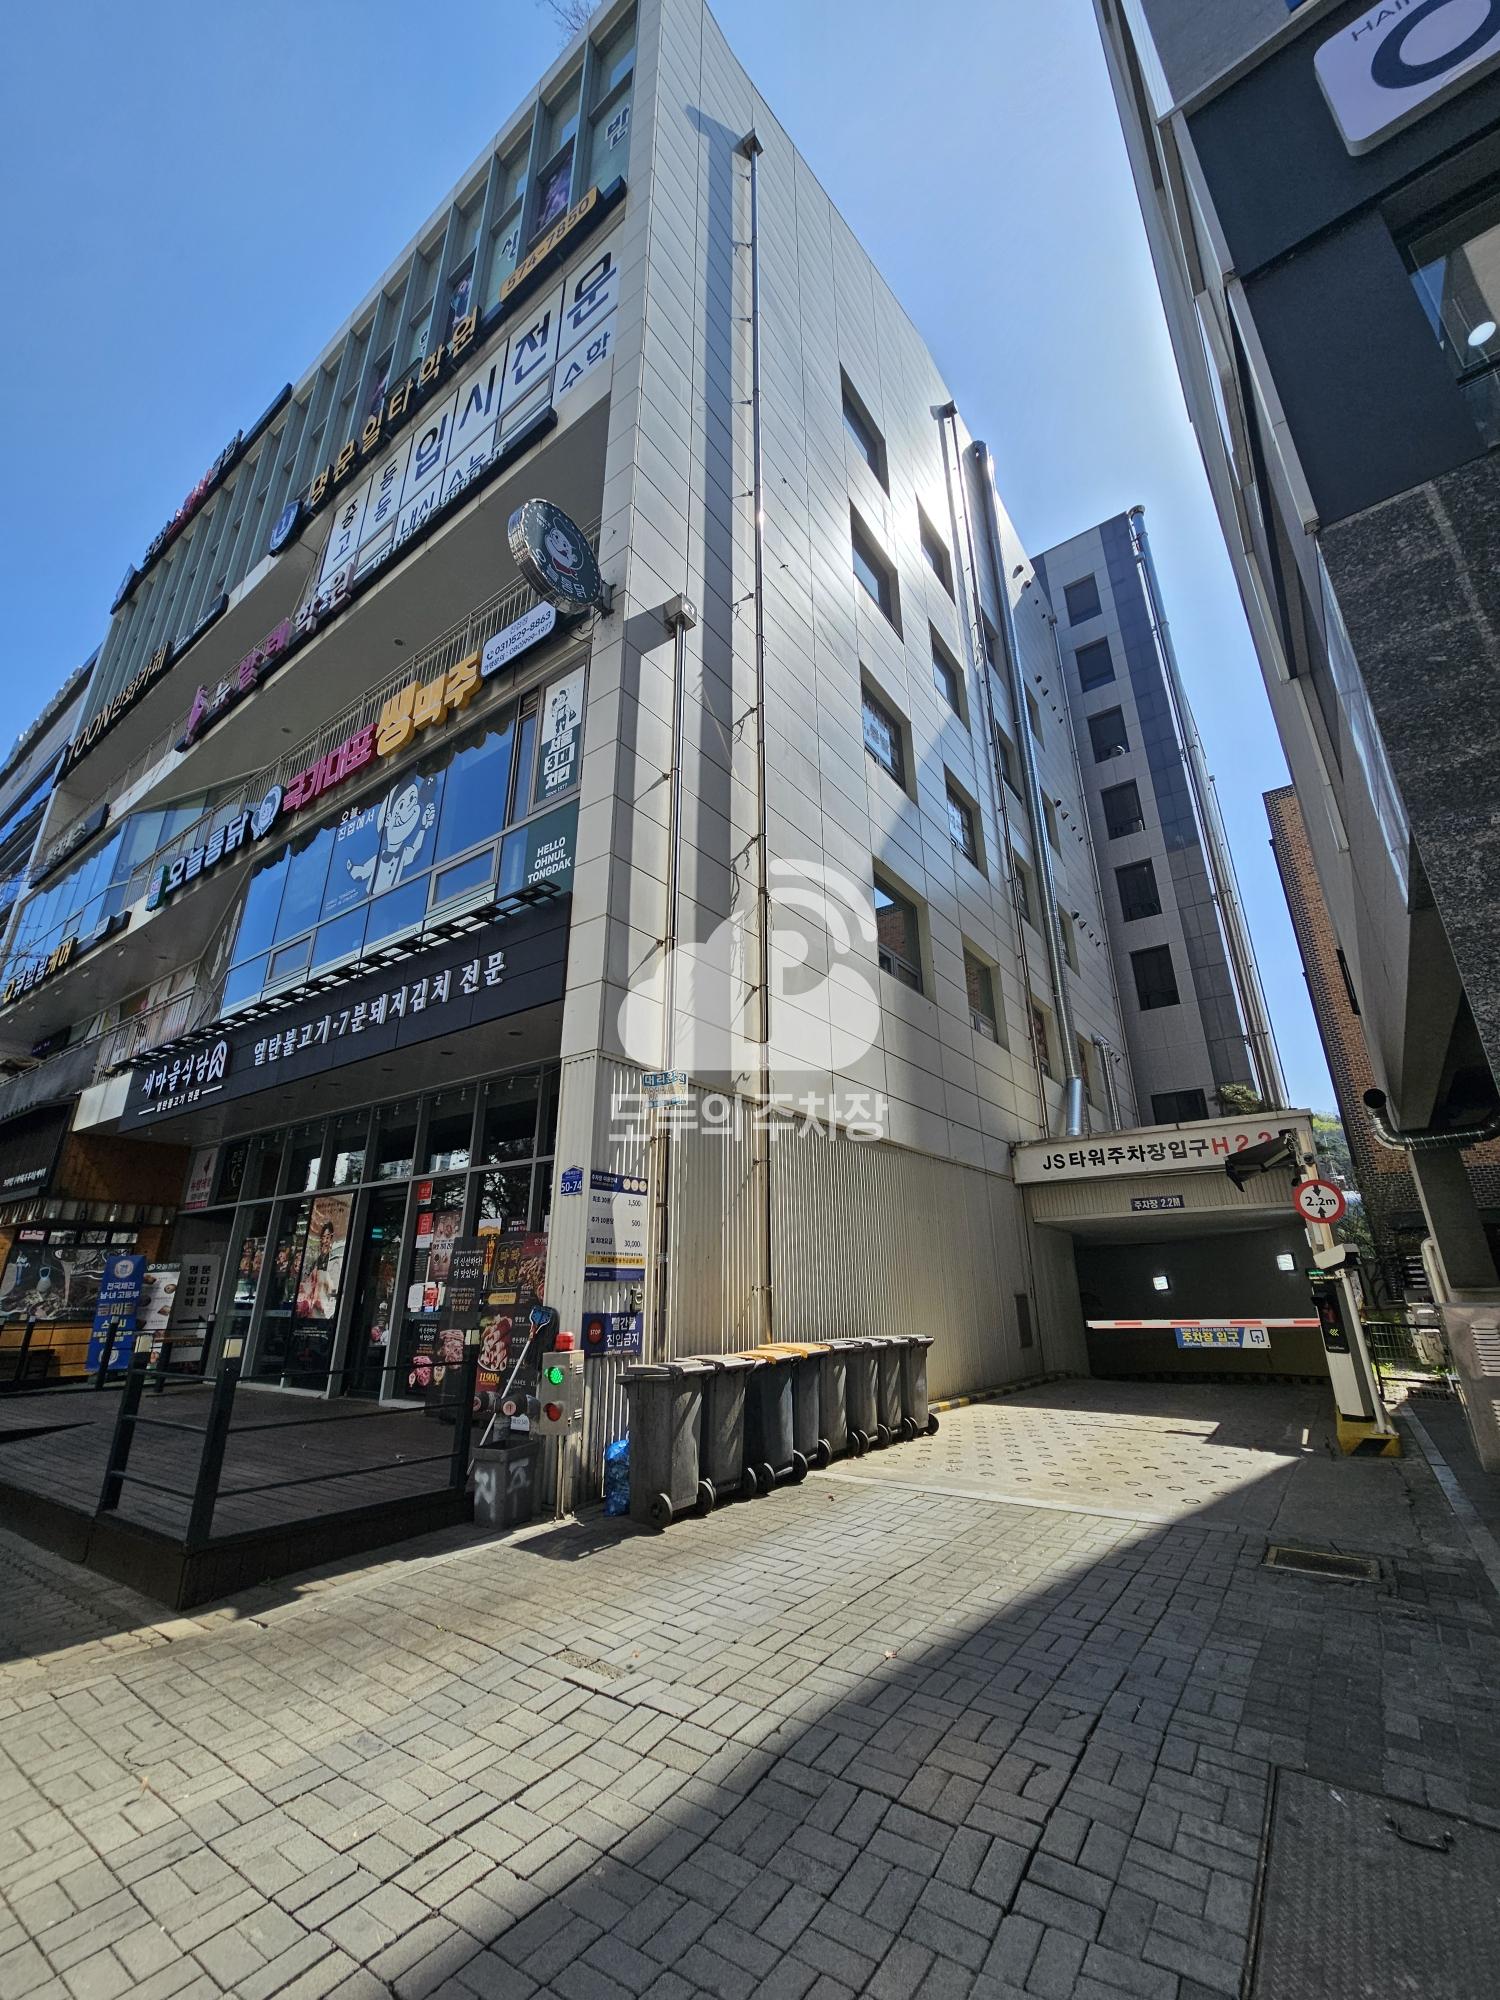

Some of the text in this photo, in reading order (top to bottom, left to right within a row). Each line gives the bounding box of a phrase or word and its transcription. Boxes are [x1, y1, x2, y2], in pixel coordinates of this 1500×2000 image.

[1351, 0, 1412, 41] HAI
[506, 197, 590, 291] 574-7850
[560, 331, 610, 392] 수학
[546, 746, 571, 771] 3대
[545, 764, 570, 790] 치킨
[165, 811, 249, 893] 오늘통닭
[283, 723, 375, 812] 국가대표
[534, 849, 566, 869] OHNUL
[537, 837, 566, 857] HELLO
[527, 857, 572, 885] TONGDAK
[460, 952, 506, 994] 전문
[141, 1049, 209, 1099] 새마을식당
[561, 1181, 582, 1193] 50-74
[1134, 1197, 1181, 1210] 주차장 2.2M
[1305, 1196, 1337, 1207] 2.2m
[611, 1316, 636, 1331] 빨간불
[606, 1332, 640, 1348] 진입금지
[1183, 1331, 1239, 1343] 주차장 입구
